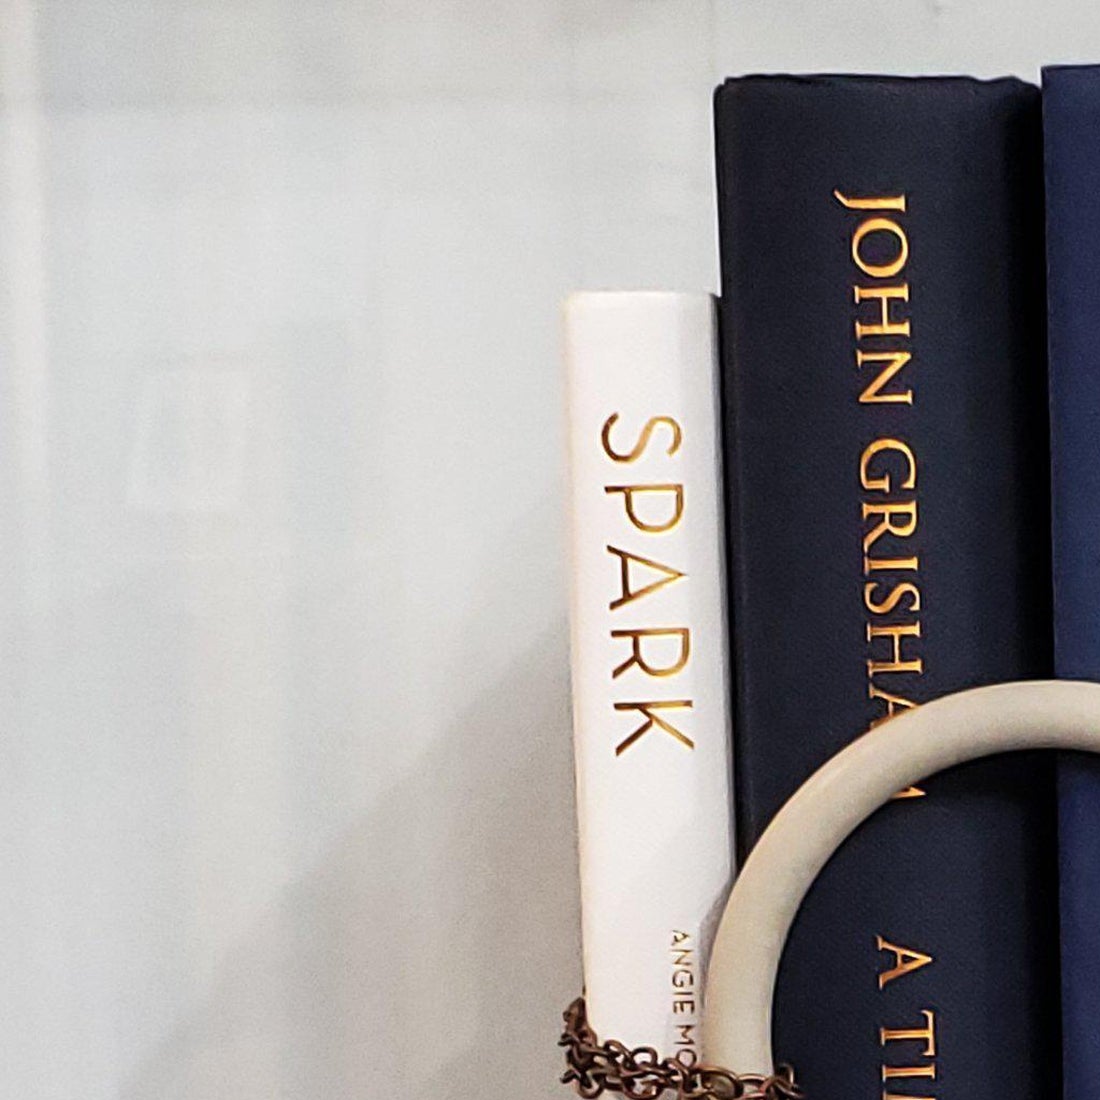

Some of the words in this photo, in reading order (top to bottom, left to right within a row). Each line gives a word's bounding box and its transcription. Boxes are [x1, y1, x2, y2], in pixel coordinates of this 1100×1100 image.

[833, 188, 913, 405] JOHN
[600, 411, 695, 757] SPARK
[860, 438, 927, 799] GRISHA
[671, 929, 696, 1014] ANGIE
[877, 935, 933, 990] A
